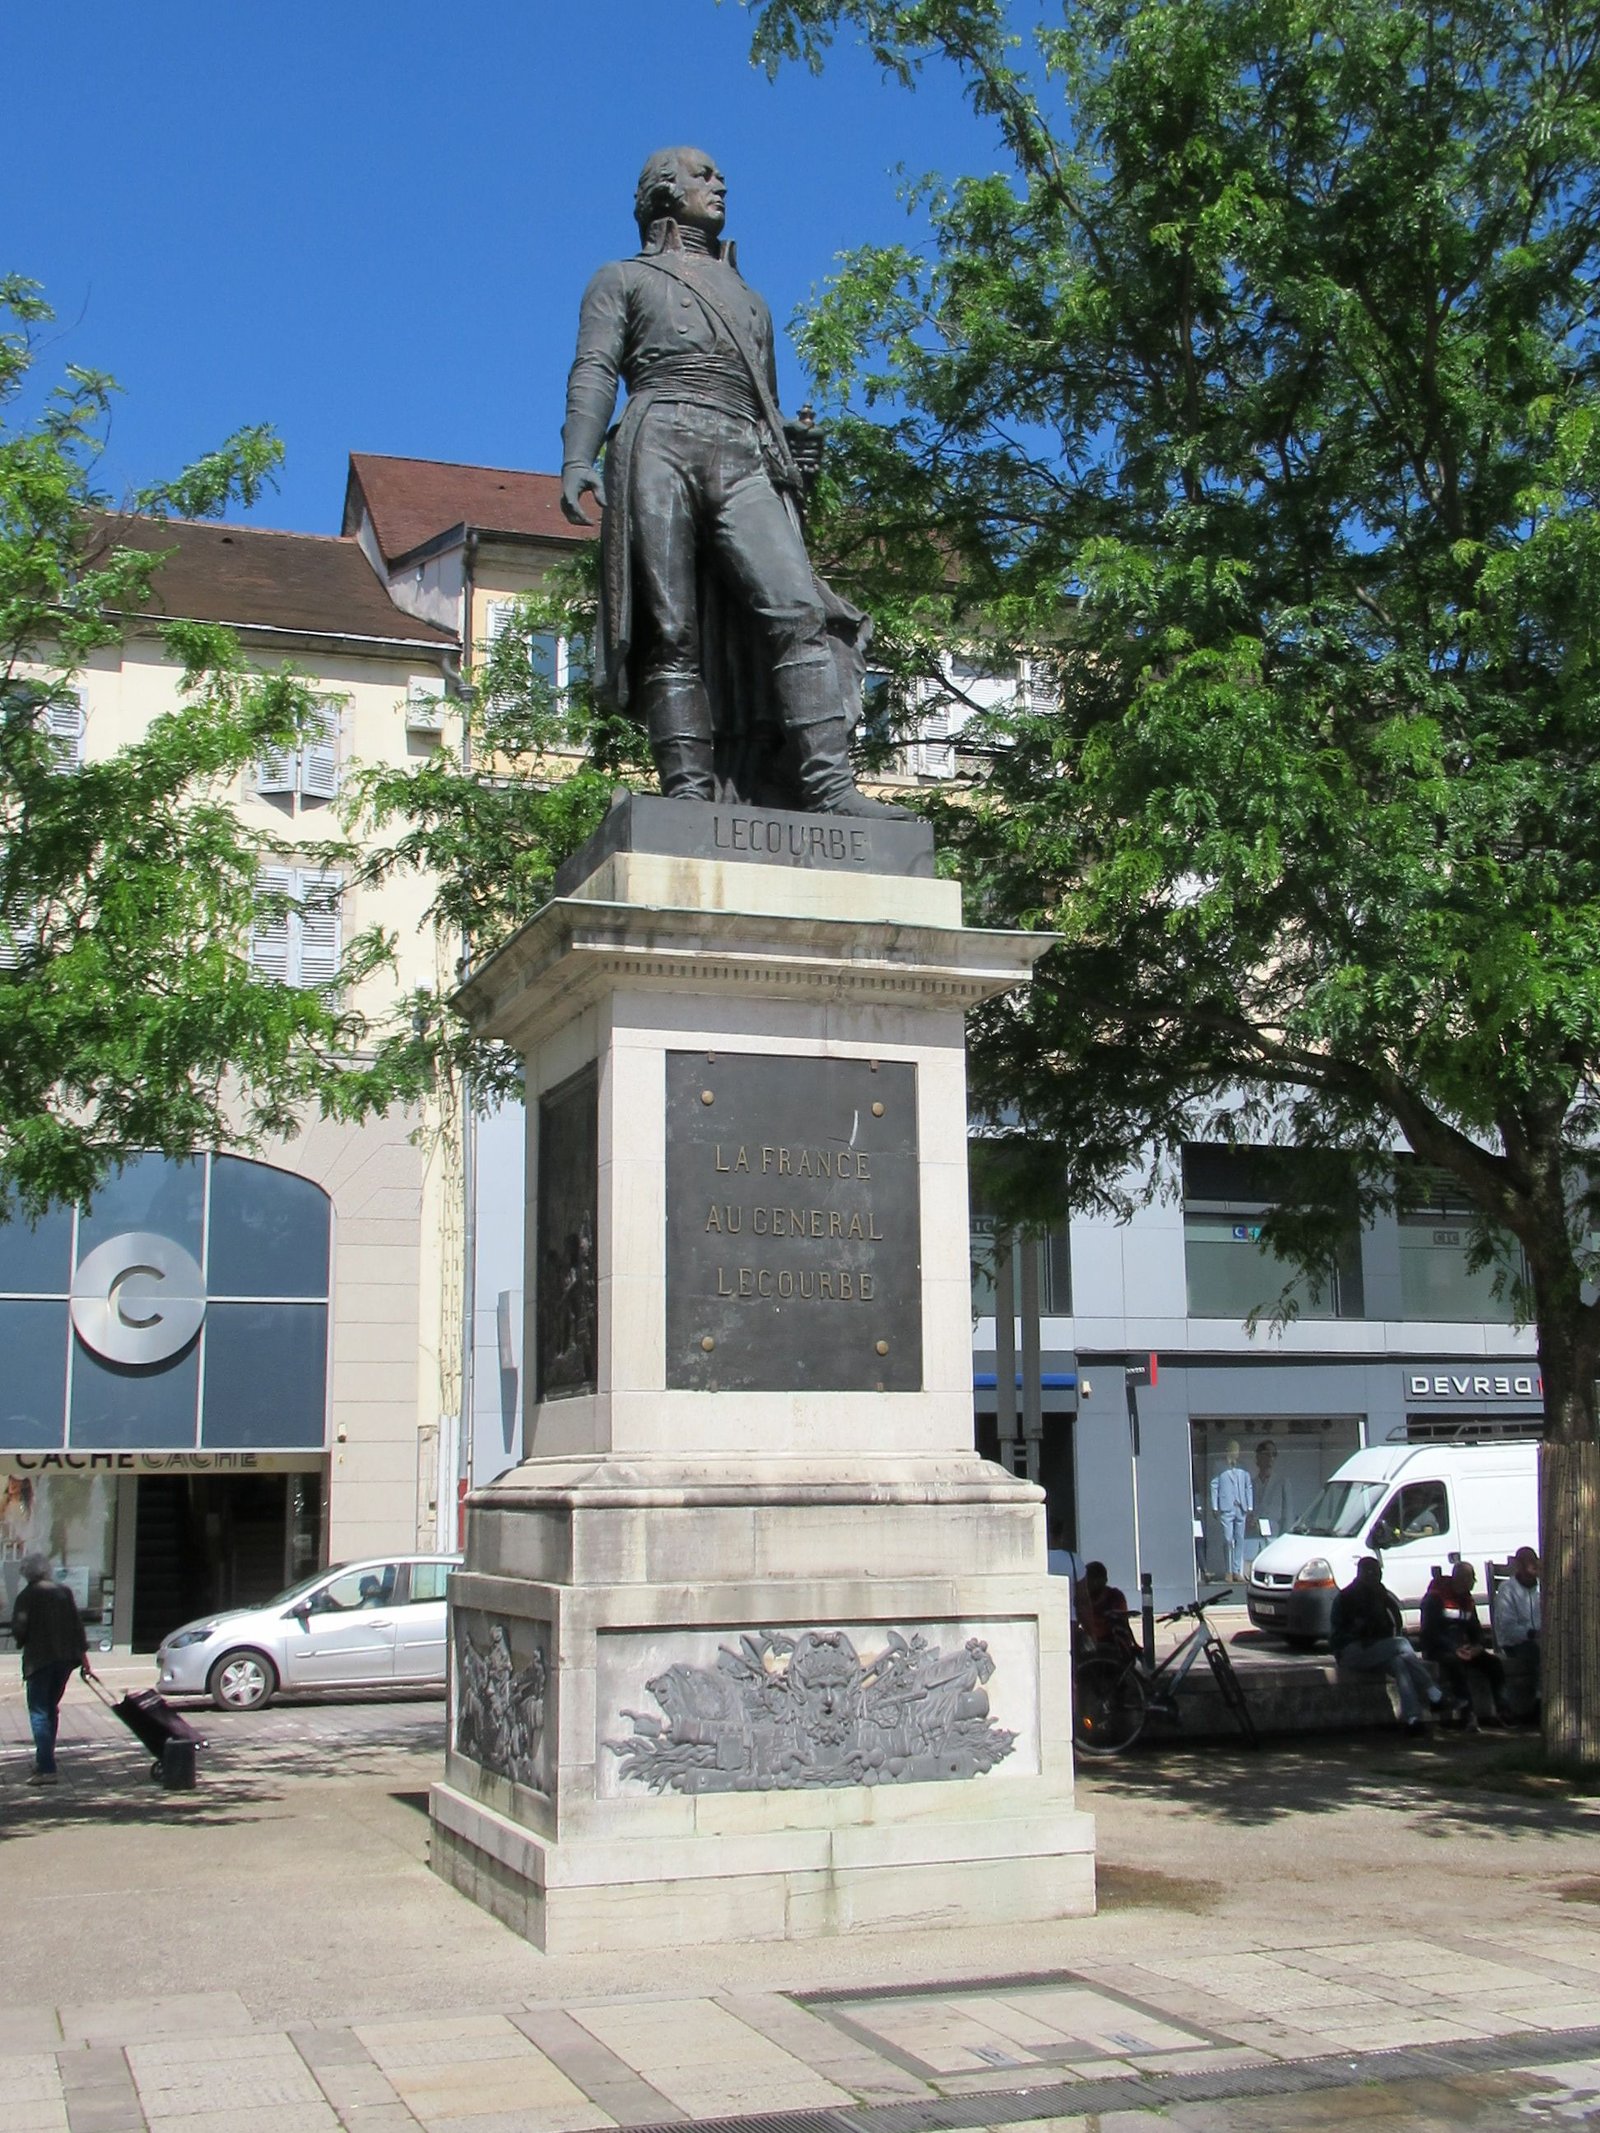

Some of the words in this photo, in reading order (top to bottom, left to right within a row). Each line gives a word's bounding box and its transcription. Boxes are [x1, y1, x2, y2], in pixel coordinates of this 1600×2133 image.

[714, 815, 865, 861] LECOURBE
[715, 1144, 750, 1173] LA
[761, 1146, 871, 1181] FRANCE
[705, 1205, 742, 1234] AU
[753, 1207, 883, 1241] GENERAL
[717, 1267, 874, 1301] LECOURBE
